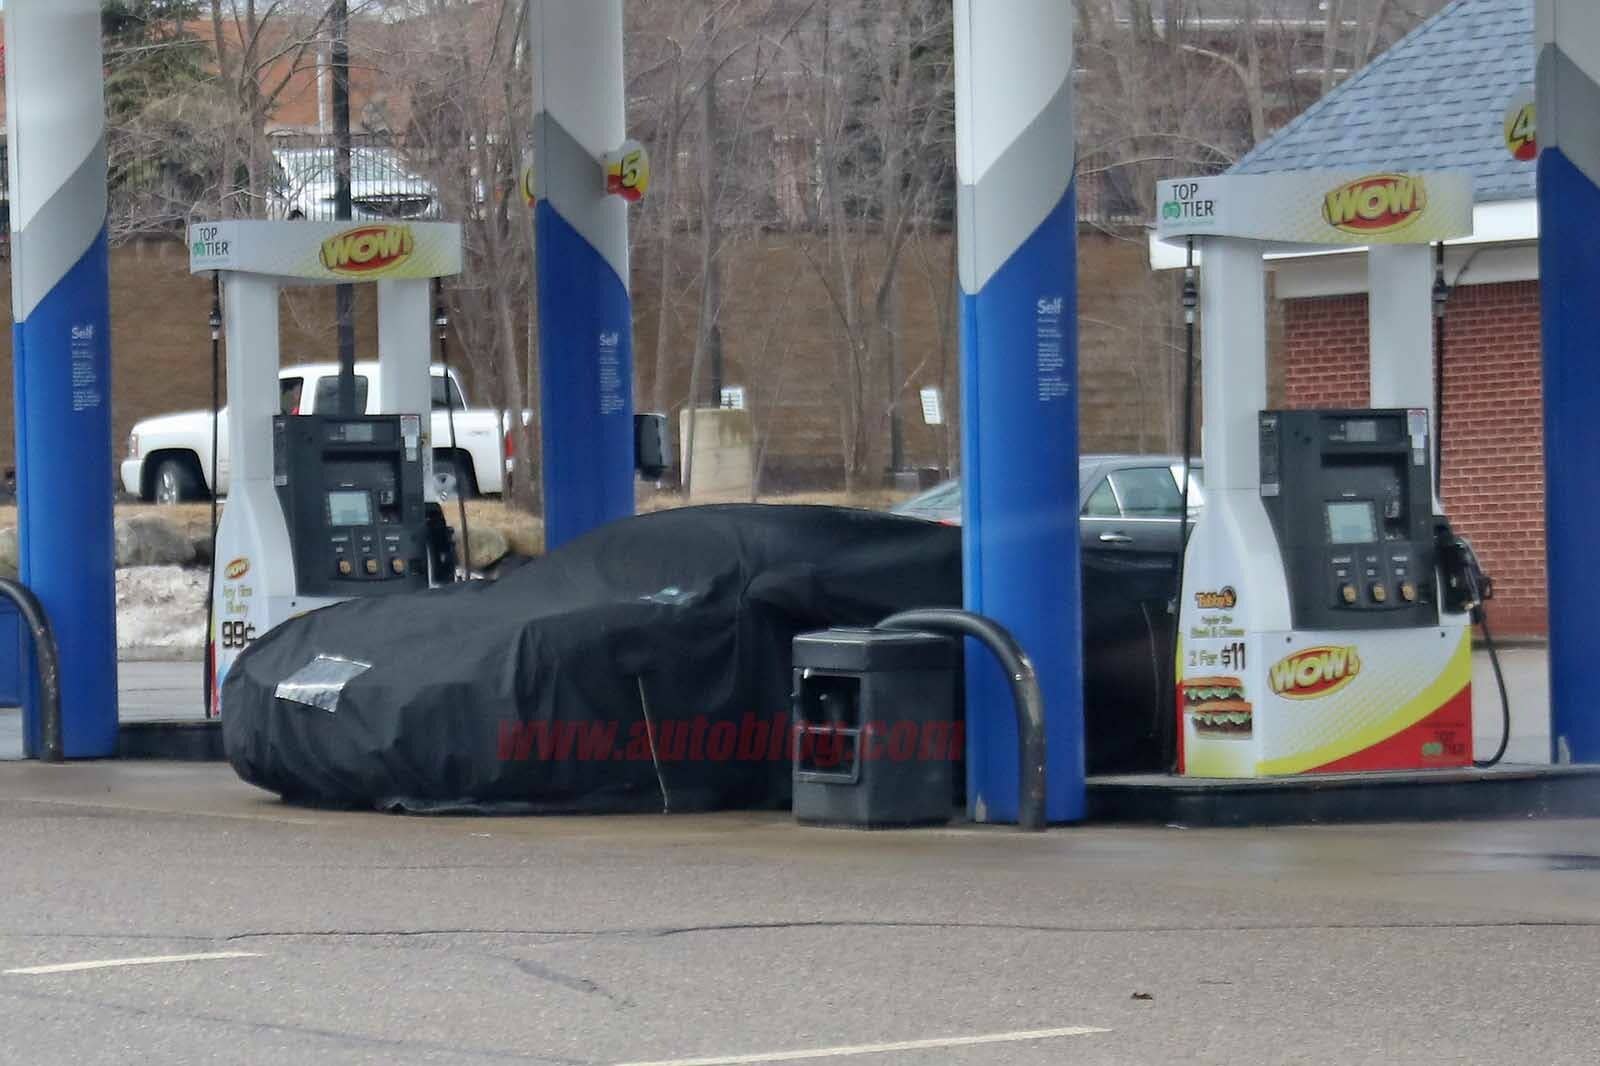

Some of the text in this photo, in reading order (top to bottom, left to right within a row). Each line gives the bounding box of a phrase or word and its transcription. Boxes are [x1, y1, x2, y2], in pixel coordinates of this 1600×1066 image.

[1509, 103, 1537, 146] 4
[620, 148, 642, 189] 5
[1172, 183, 1199, 201] TOP
[1325, 177, 1425, 226] WOW!
[1181, 200, 1215, 217] TIER
[199, 227, 218, 241] TOP
[205, 241, 229, 256] TIER
[321, 226, 413, 270] WOW!
[1037, 297, 1063, 314] Self
[71, 325, 94, 340] Self
[1221, 642, 1246, 671] $11
[1270, 645, 1358, 695] WOW!
